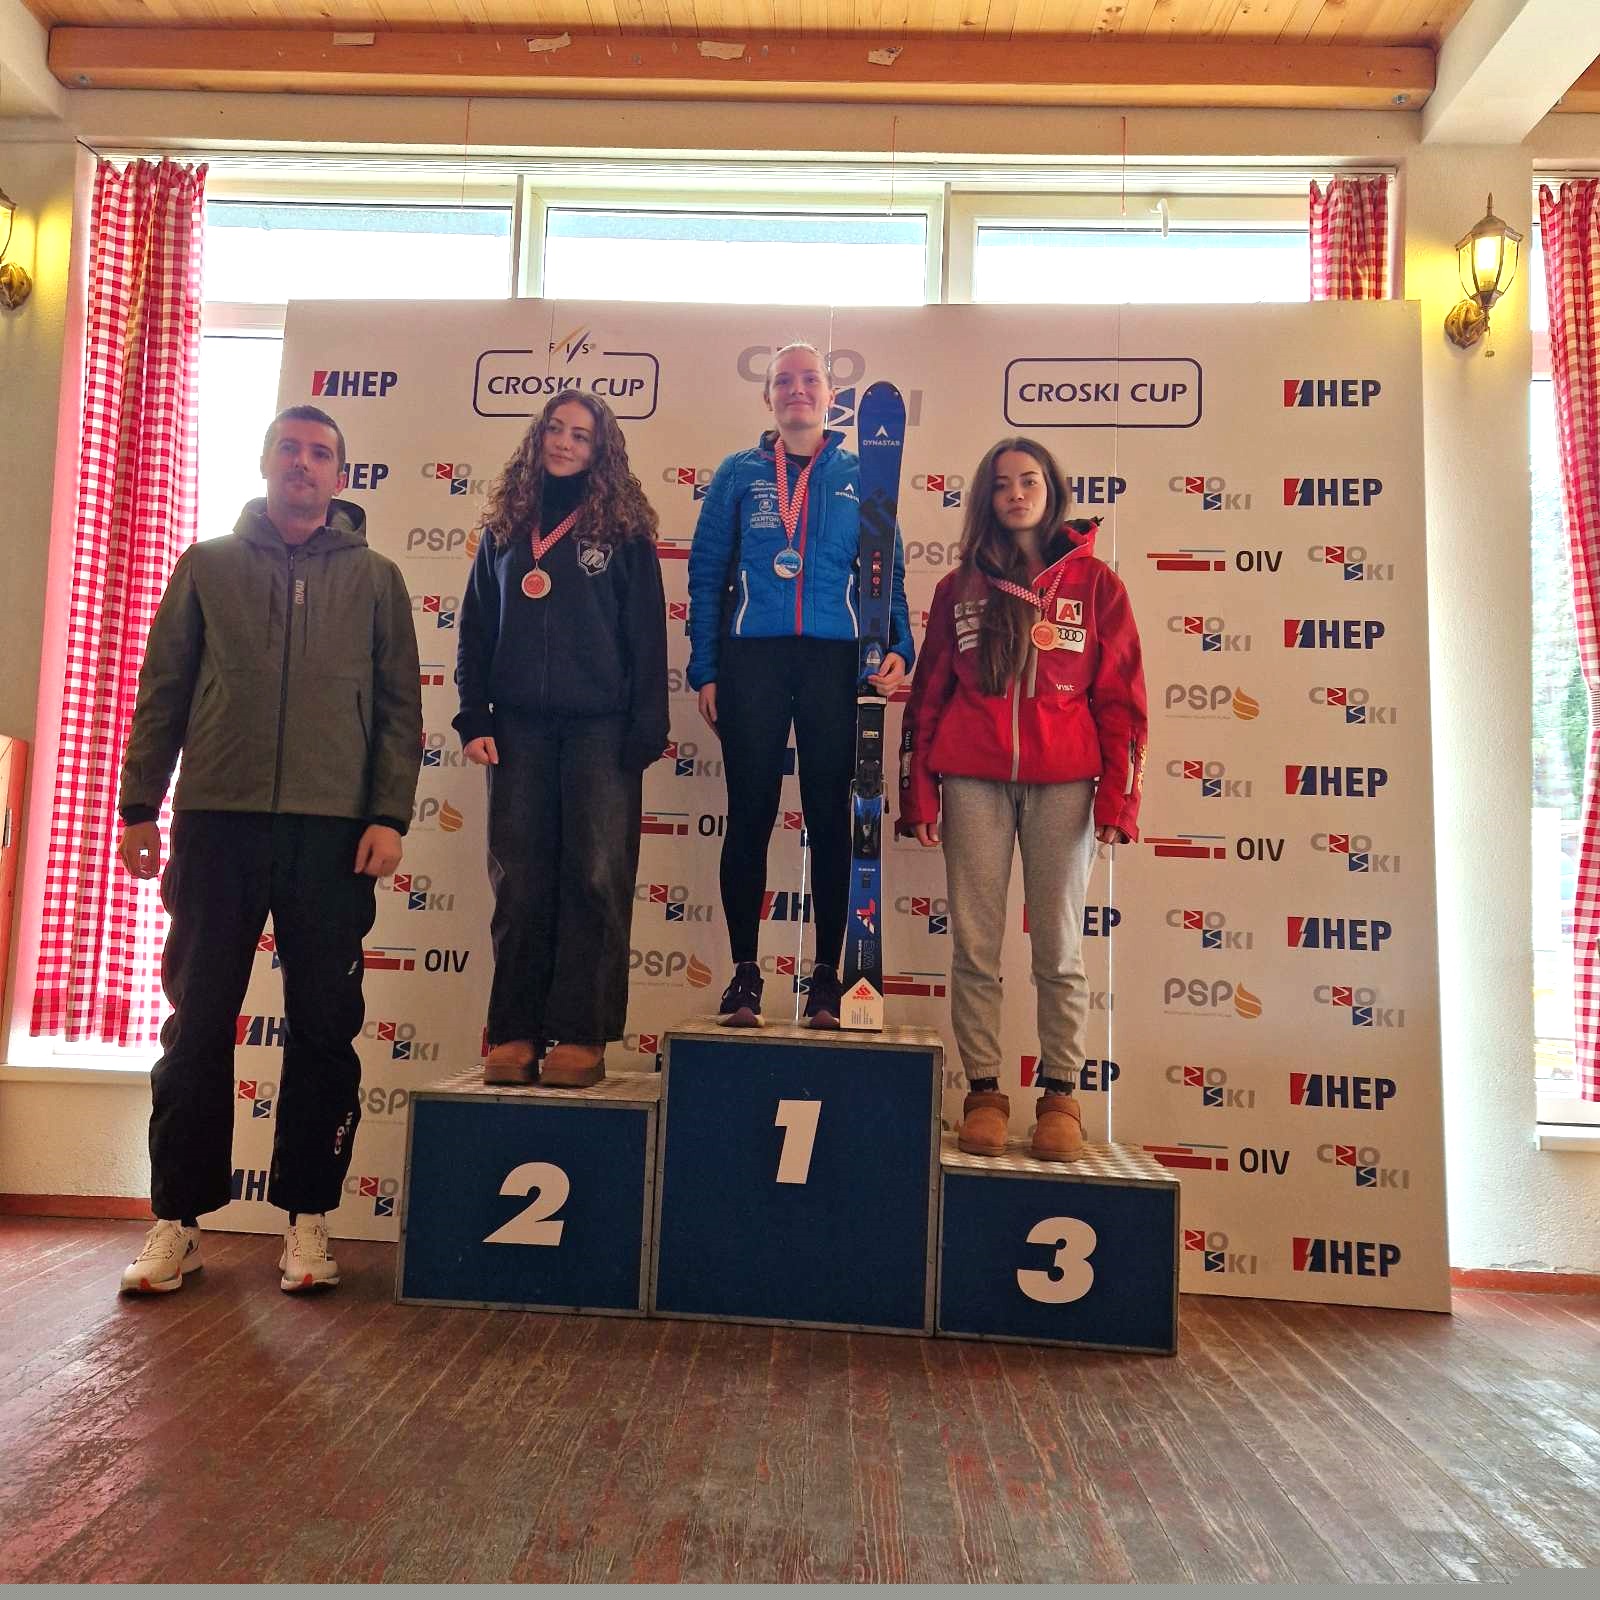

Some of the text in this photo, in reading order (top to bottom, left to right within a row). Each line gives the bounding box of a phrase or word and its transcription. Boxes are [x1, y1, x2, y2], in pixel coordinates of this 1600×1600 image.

[342, 370, 398, 397] HEP
[487, 376, 645, 397] CROSKI CUP
[1018, 383, 1188, 403] CROSKI CUP
[1317, 379, 1382, 407] HEP
[862, 439, 901, 447] DYNASTAR
[1065, 476, 1127, 504] HEP
[1318, 478, 1384, 507] HEP
[406, 527, 466, 552] PSP
[1235, 550, 1284, 573] OIV
[1058, 602, 1081, 621] A1
[1319, 619, 1386, 650] HEP
[1165, 683, 1232, 711] PSP
[1321, 765, 1388, 798] HEP
[1236, 836, 1286, 862] OIV
[1083, 904, 1122, 937] EP
[1323, 916, 1393, 952] HEP
[423, 949, 470, 974] OIV
[1163, 976, 1234, 1008] PSP
[1079, 1058, 1121, 1092] EP
[1326, 1074, 1397, 1111] HEP
[774, 1098, 823, 1185] 1
[1239, 1146, 1290, 1176] OIV
[481, 1161, 570, 1247] 2
[1016, 1216, 1098, 1304] 3
[1330, 1239, 1402, 1278] HEP
